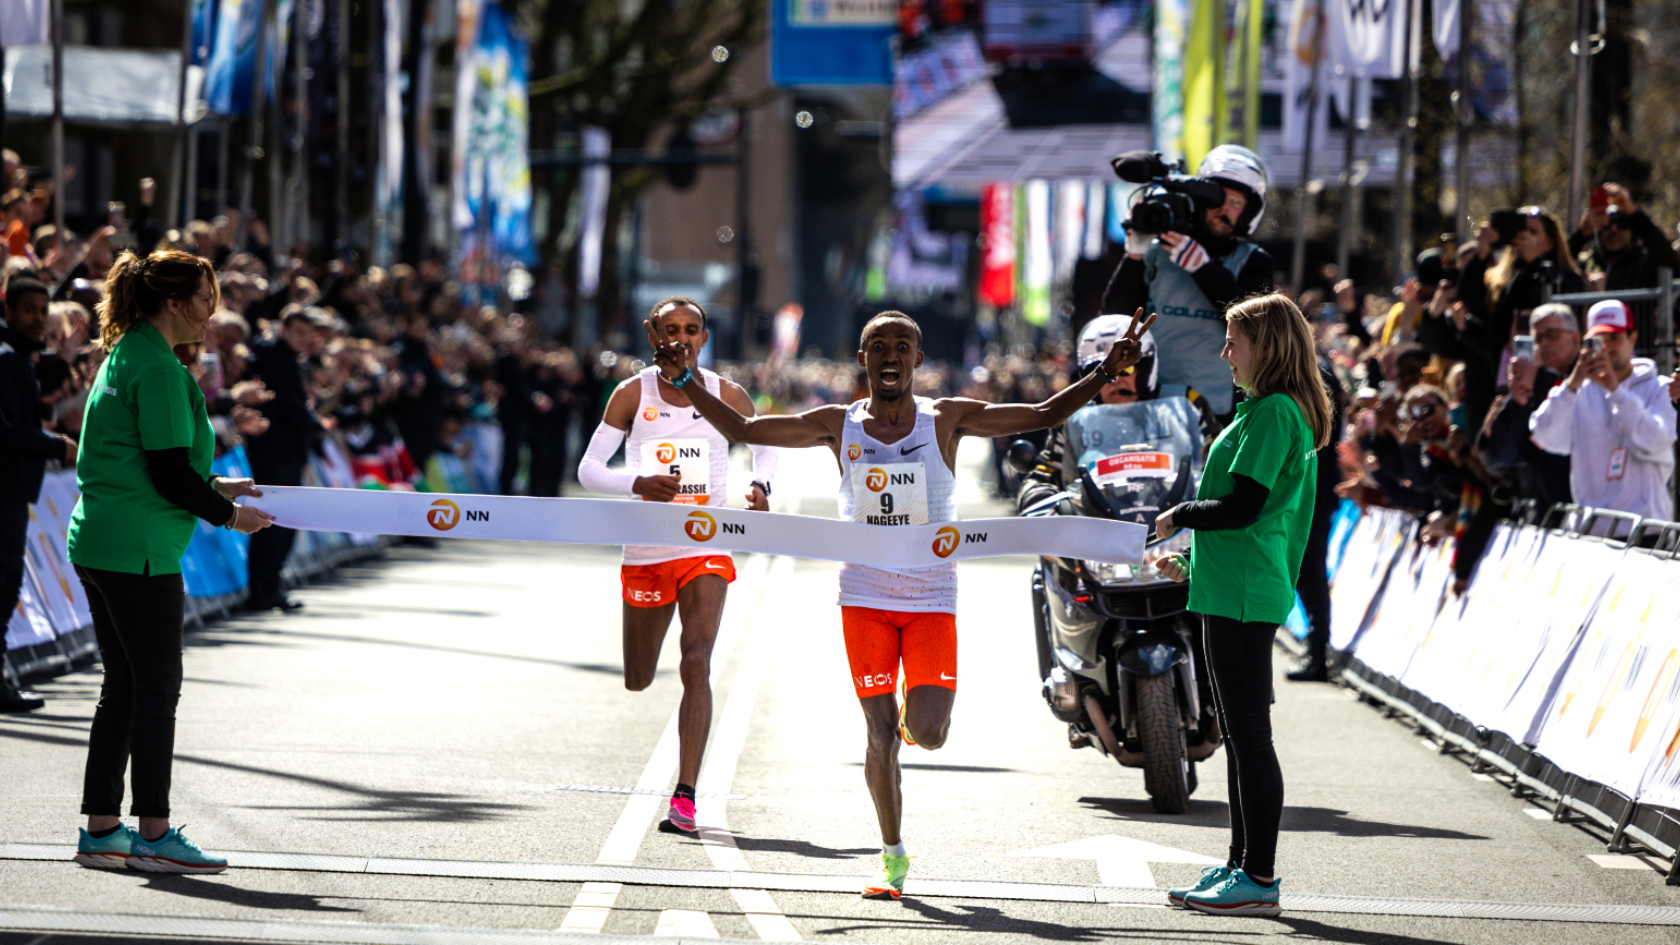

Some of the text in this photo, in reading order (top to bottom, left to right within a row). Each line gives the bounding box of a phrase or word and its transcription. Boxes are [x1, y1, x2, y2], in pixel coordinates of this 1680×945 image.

[679, 447, 700, 458] NN
[890, 473, 915, 485] NN
[880, 492, 894, 514] 9
[466, 510, 490, 522] NN
[721, 522, 745, 535] NN
[965, 532, 988, 544] NN
